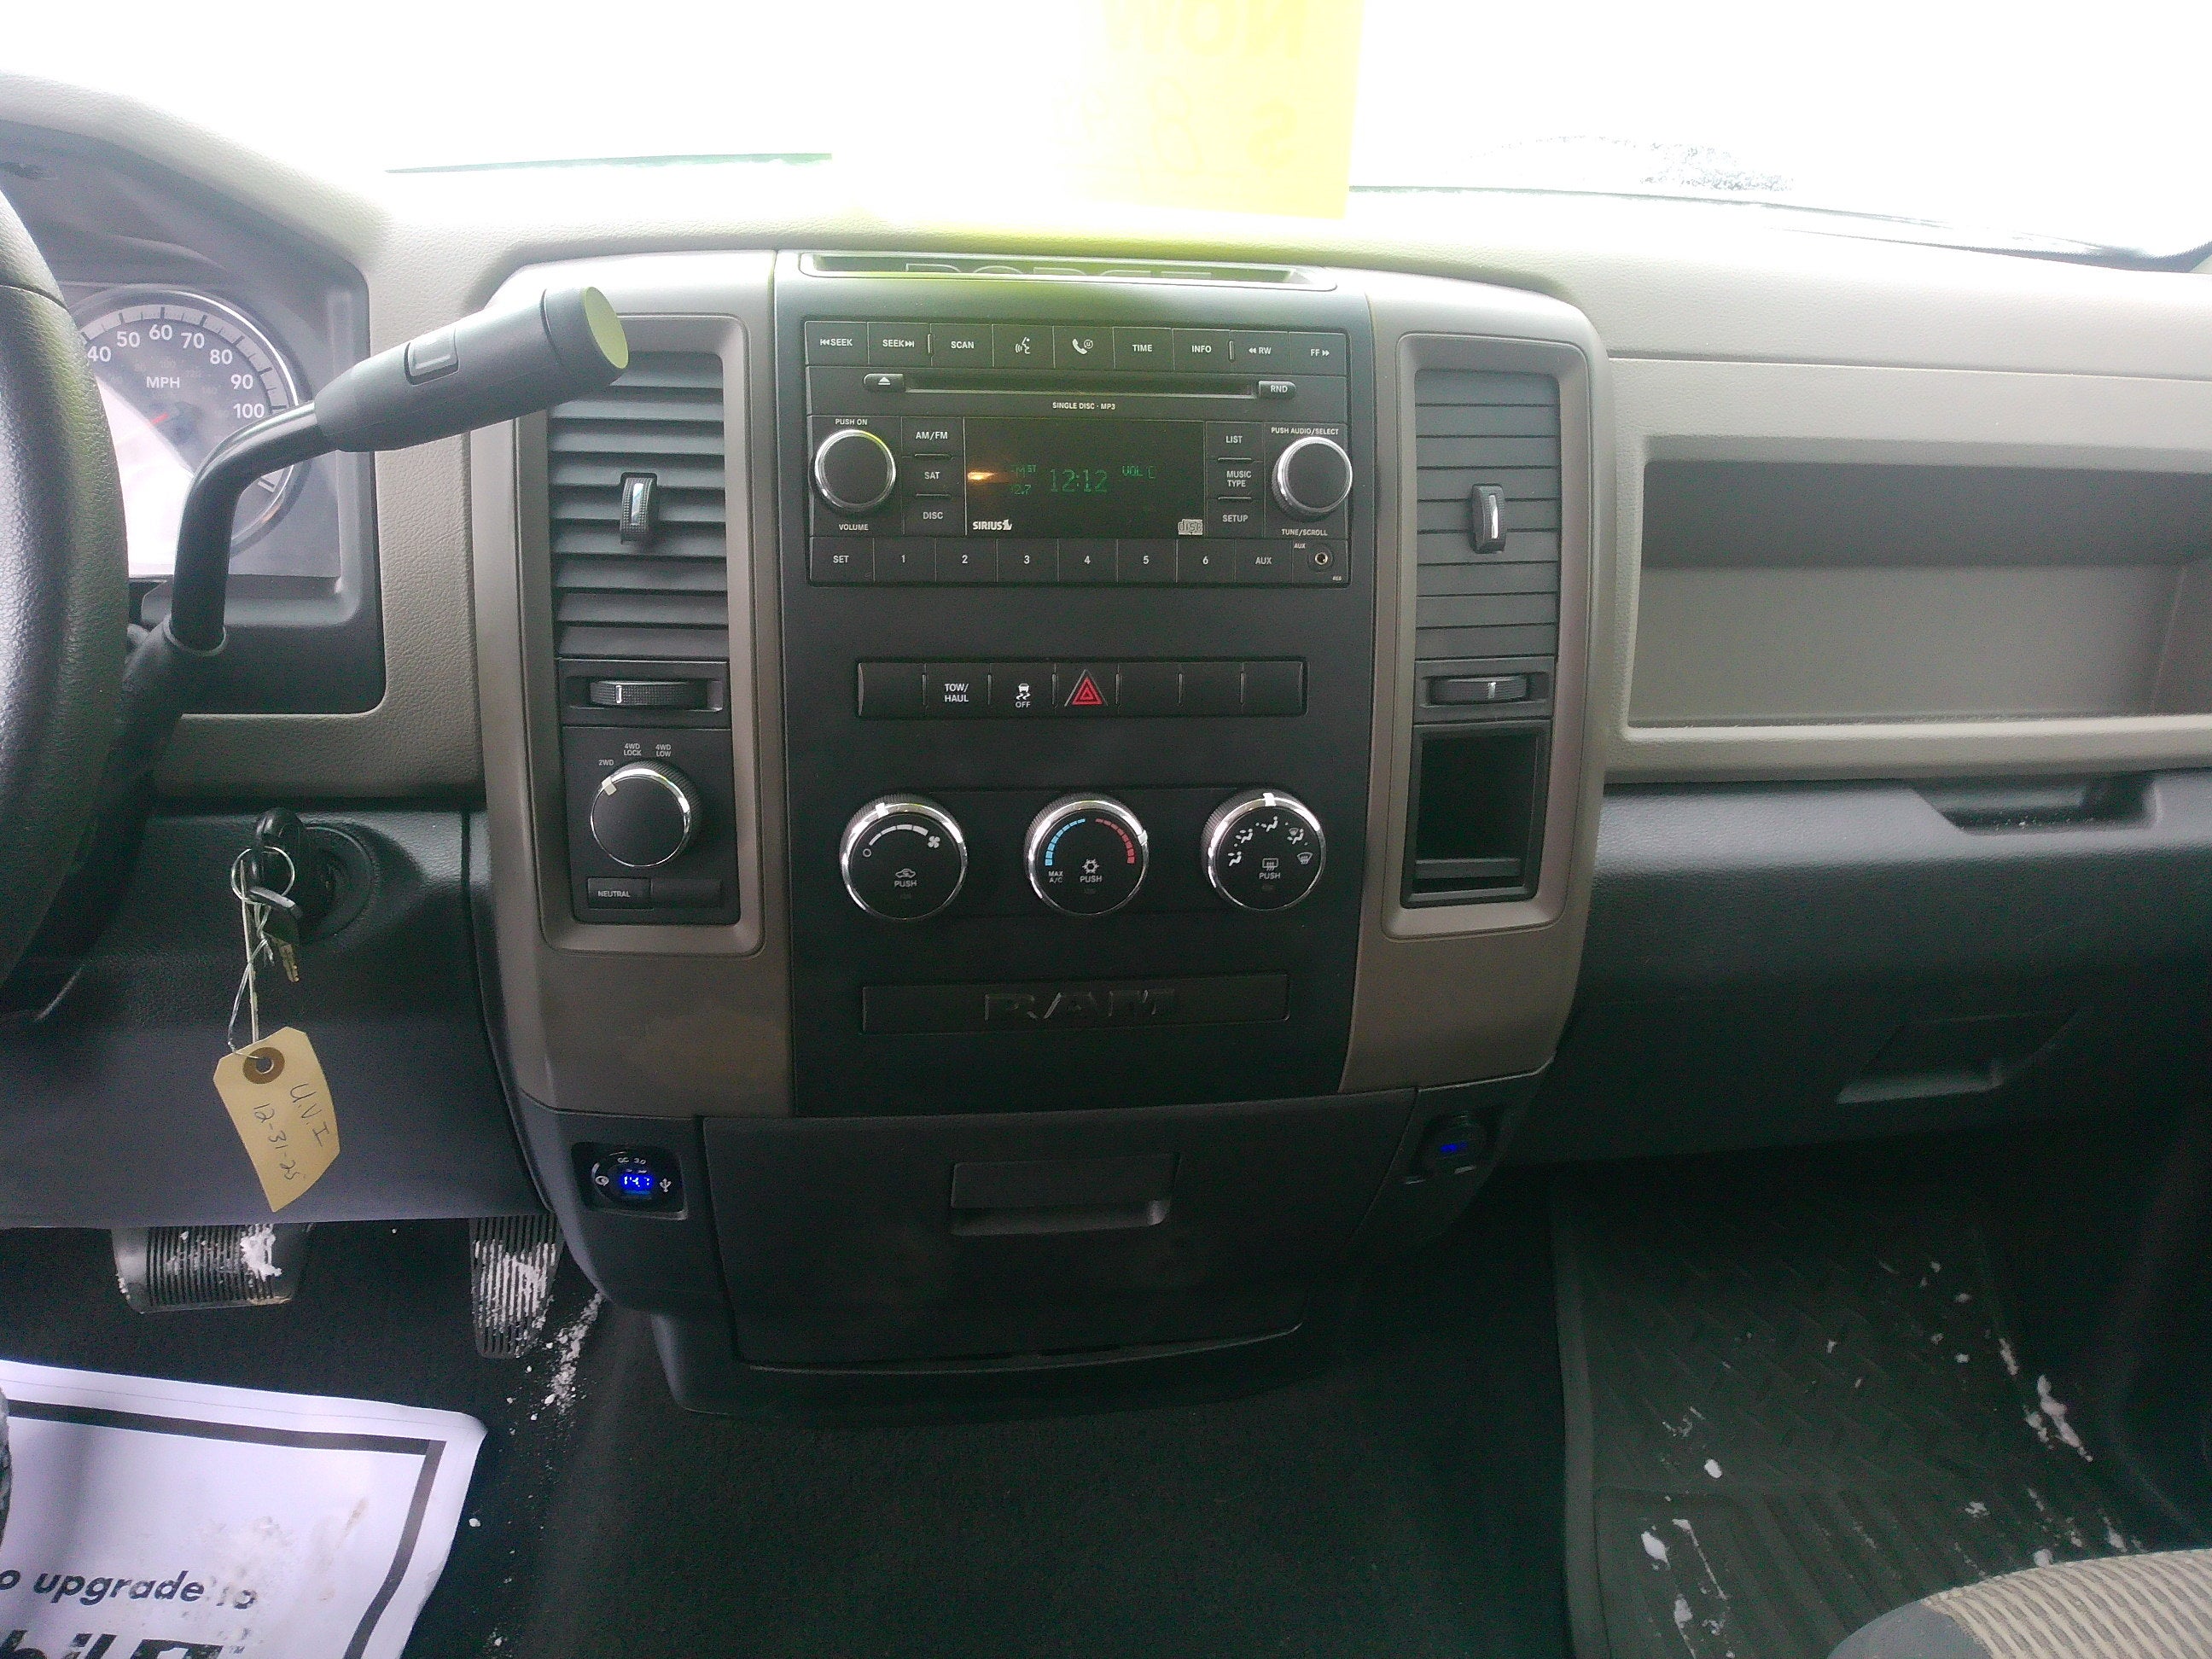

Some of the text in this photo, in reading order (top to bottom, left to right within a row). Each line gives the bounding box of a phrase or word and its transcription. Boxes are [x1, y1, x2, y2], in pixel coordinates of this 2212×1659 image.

[148, 323, 173, 341] 60
[116, 330, 141, 348] 50
[180, 332, 205, 349] 70
[830, 338, 853, 346] SEEK
[882, 339, 905, 347] SEEK
[950, 341, 975, 349] SCAN
[1191, 345, 1212, 353] INFO
[87, 346, 112, 363] 40
[1258, 346, 1272, 355] RW
[1310, 348, 1320, 357] FF
[209, 349, 233, 364] 80
[146, 376, 180, 388] MPH
[230, 374, 253, 390] 90
[232, 403, 265, 418] 100
[915, 431, 948, 440] AM/FM
[1225, 435, 1243, 444] LIST
[924, 471, 940, 480] SAT
[1226, 470, 1252, 479] MUSIC
[1050, 469, 1107, 492] 12:12
[923, 511, 944, 520] DISC
[1222, 515, 1249, 523] SETUP
[972, 521, 1003, 531] SIRIUS
[1281, 528, 1328, 537] TUNE/SCROLL
[833, 555, 849, 563] SET
[901, 555, 905, 563] 1
[962, 556, 968, 564] 2
[1024, 556, 1030, 564] 3
[1084, 556, 1091, 565] 4
[1143, 556, 1150, 565] 5
[1202, 556, 1208, 565] 6
[1255, 556, 1272, 565] AUX
[944, 684, 969, 692] TOW/
[1080, 875, 1103, 883] PUSH
[33, 1570, 205, 1605] upgrade
